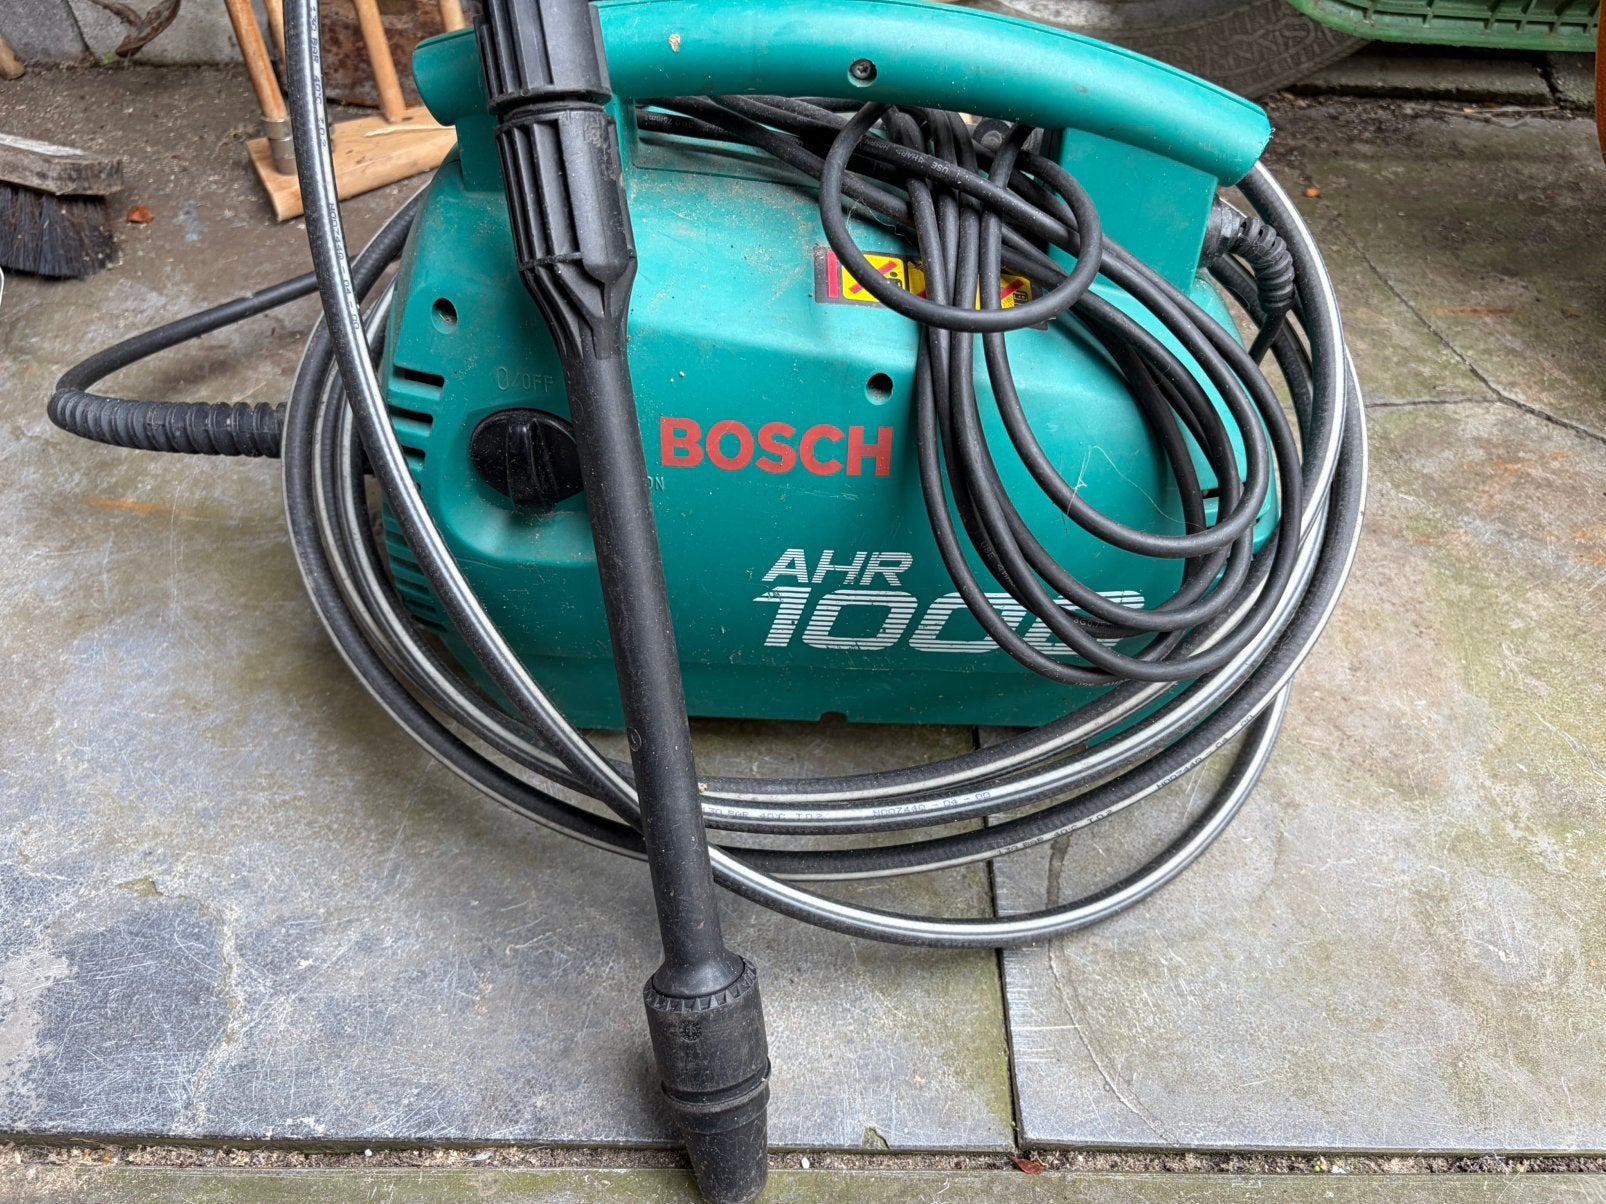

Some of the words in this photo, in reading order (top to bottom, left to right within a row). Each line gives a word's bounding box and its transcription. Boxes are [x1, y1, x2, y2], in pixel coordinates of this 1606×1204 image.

[311, 37, 319, 64] BAR
[930, 161, 949, 174] USE
[660, 416, 893, 478] BOSCH
[761, 549, 914, 586] AHR
